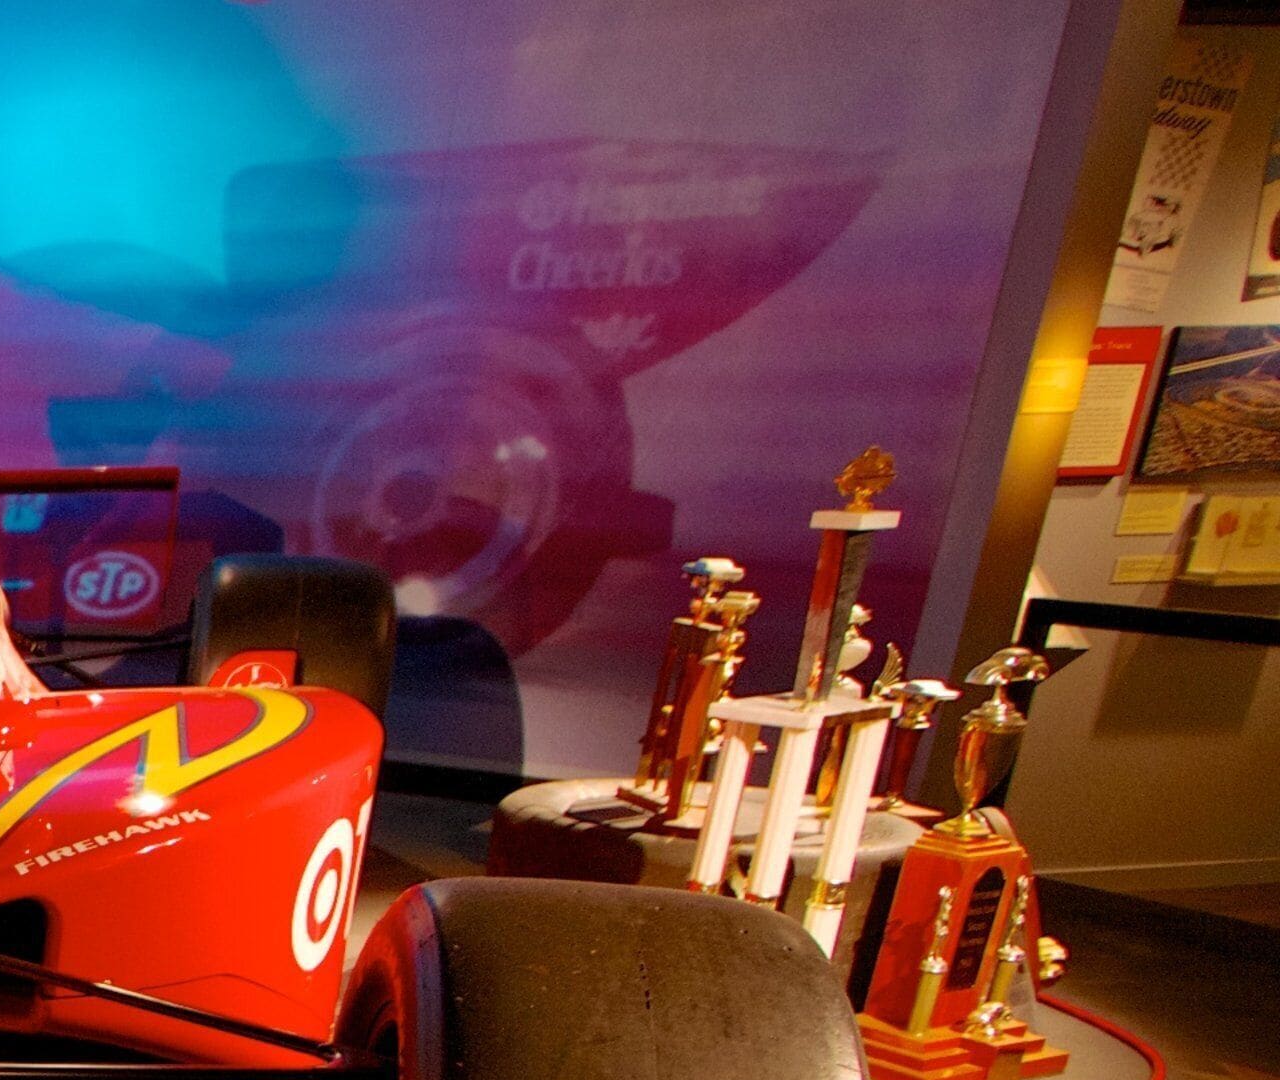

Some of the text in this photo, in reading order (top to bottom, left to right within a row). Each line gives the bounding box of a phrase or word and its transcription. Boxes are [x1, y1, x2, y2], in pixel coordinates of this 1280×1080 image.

[508, 231, 683, 291] Cheerios
[76, 562, 145, 604] STP
[13, 807, 211, 876] FIREHAWK
